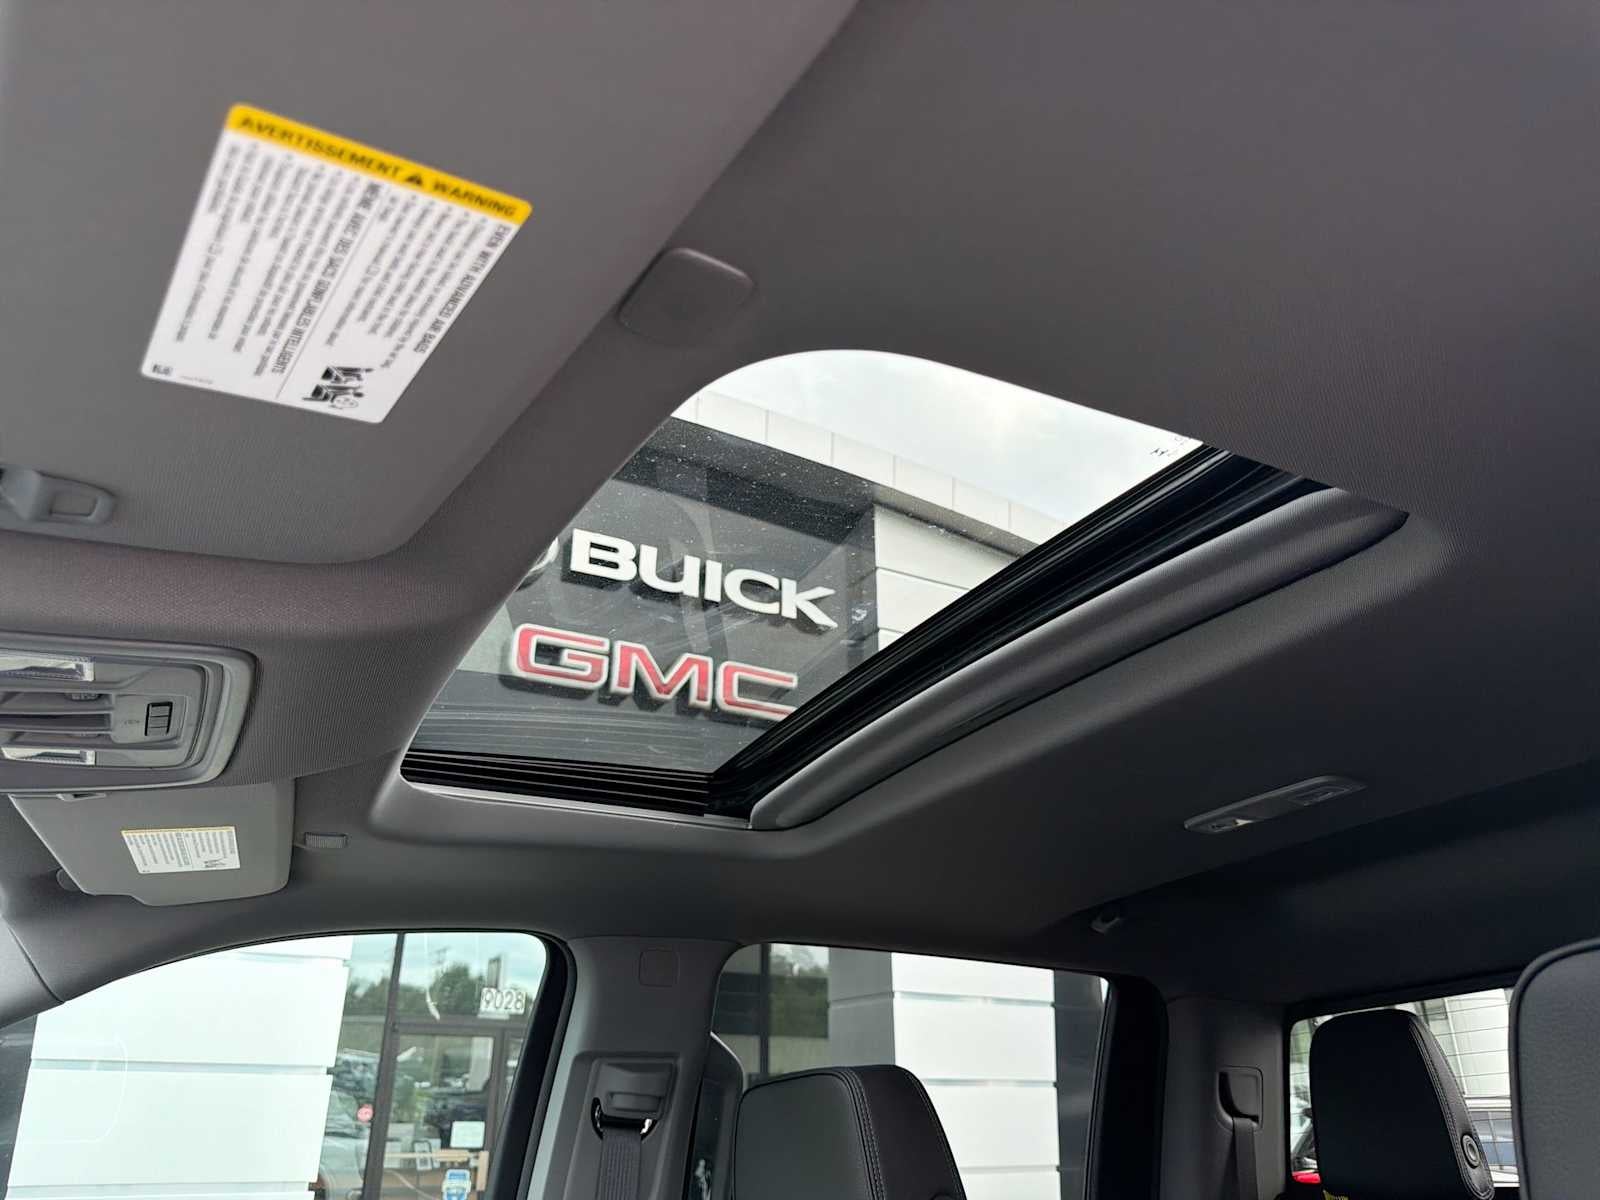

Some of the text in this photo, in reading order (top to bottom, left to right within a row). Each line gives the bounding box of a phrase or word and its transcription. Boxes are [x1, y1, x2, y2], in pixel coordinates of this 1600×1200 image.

[241, 115, 400, 177] AVERTISSEMENT
[433, 180, 517, 218] WARNING
[412, 223, 511, 354] EVEN WITH ADVANCED AIR BAGS
[570, 528, 838, 628] BUICK
[511, 623, 798, 722] GMC
[484, 989, 525, 1010] 9028
